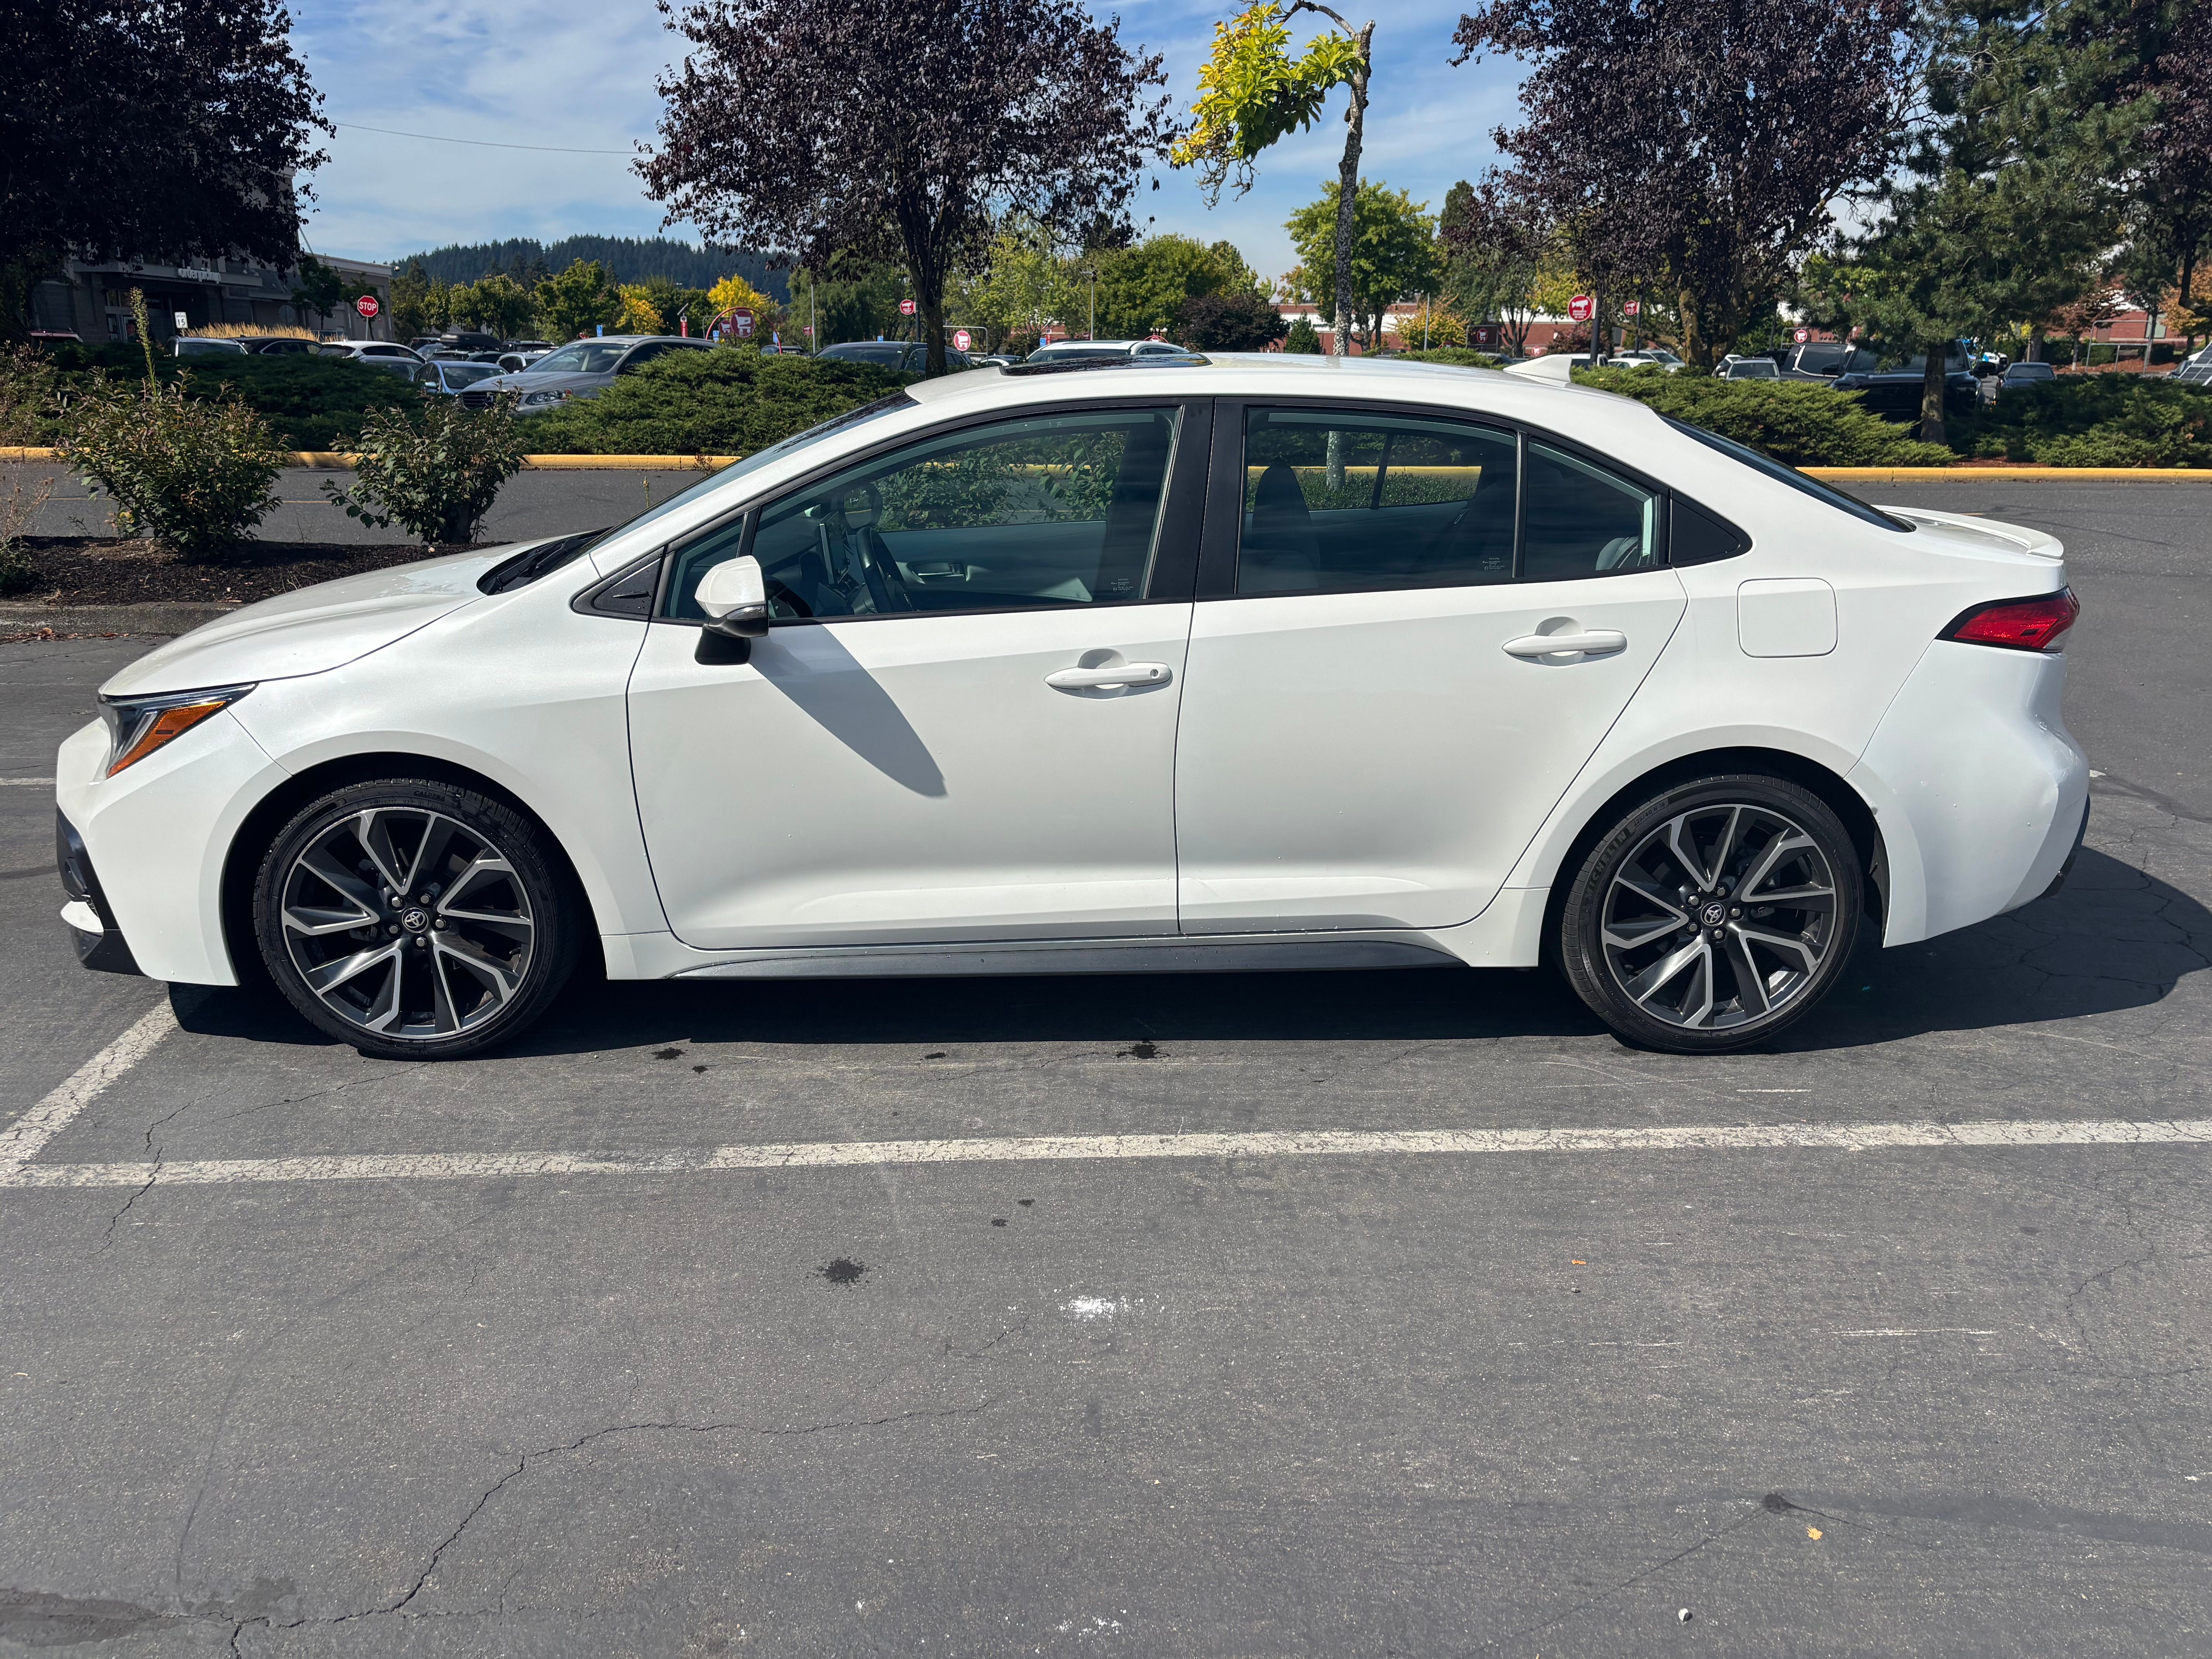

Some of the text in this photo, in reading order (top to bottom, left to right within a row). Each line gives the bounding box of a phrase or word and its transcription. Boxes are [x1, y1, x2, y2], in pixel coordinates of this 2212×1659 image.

[359, 302, 376, 311] STOP
[415, 790, 445, 801] CALDERA
[1633, 810, 1652, 826] 225/40
[1585, 831, 1628, 899] MICHELIN
